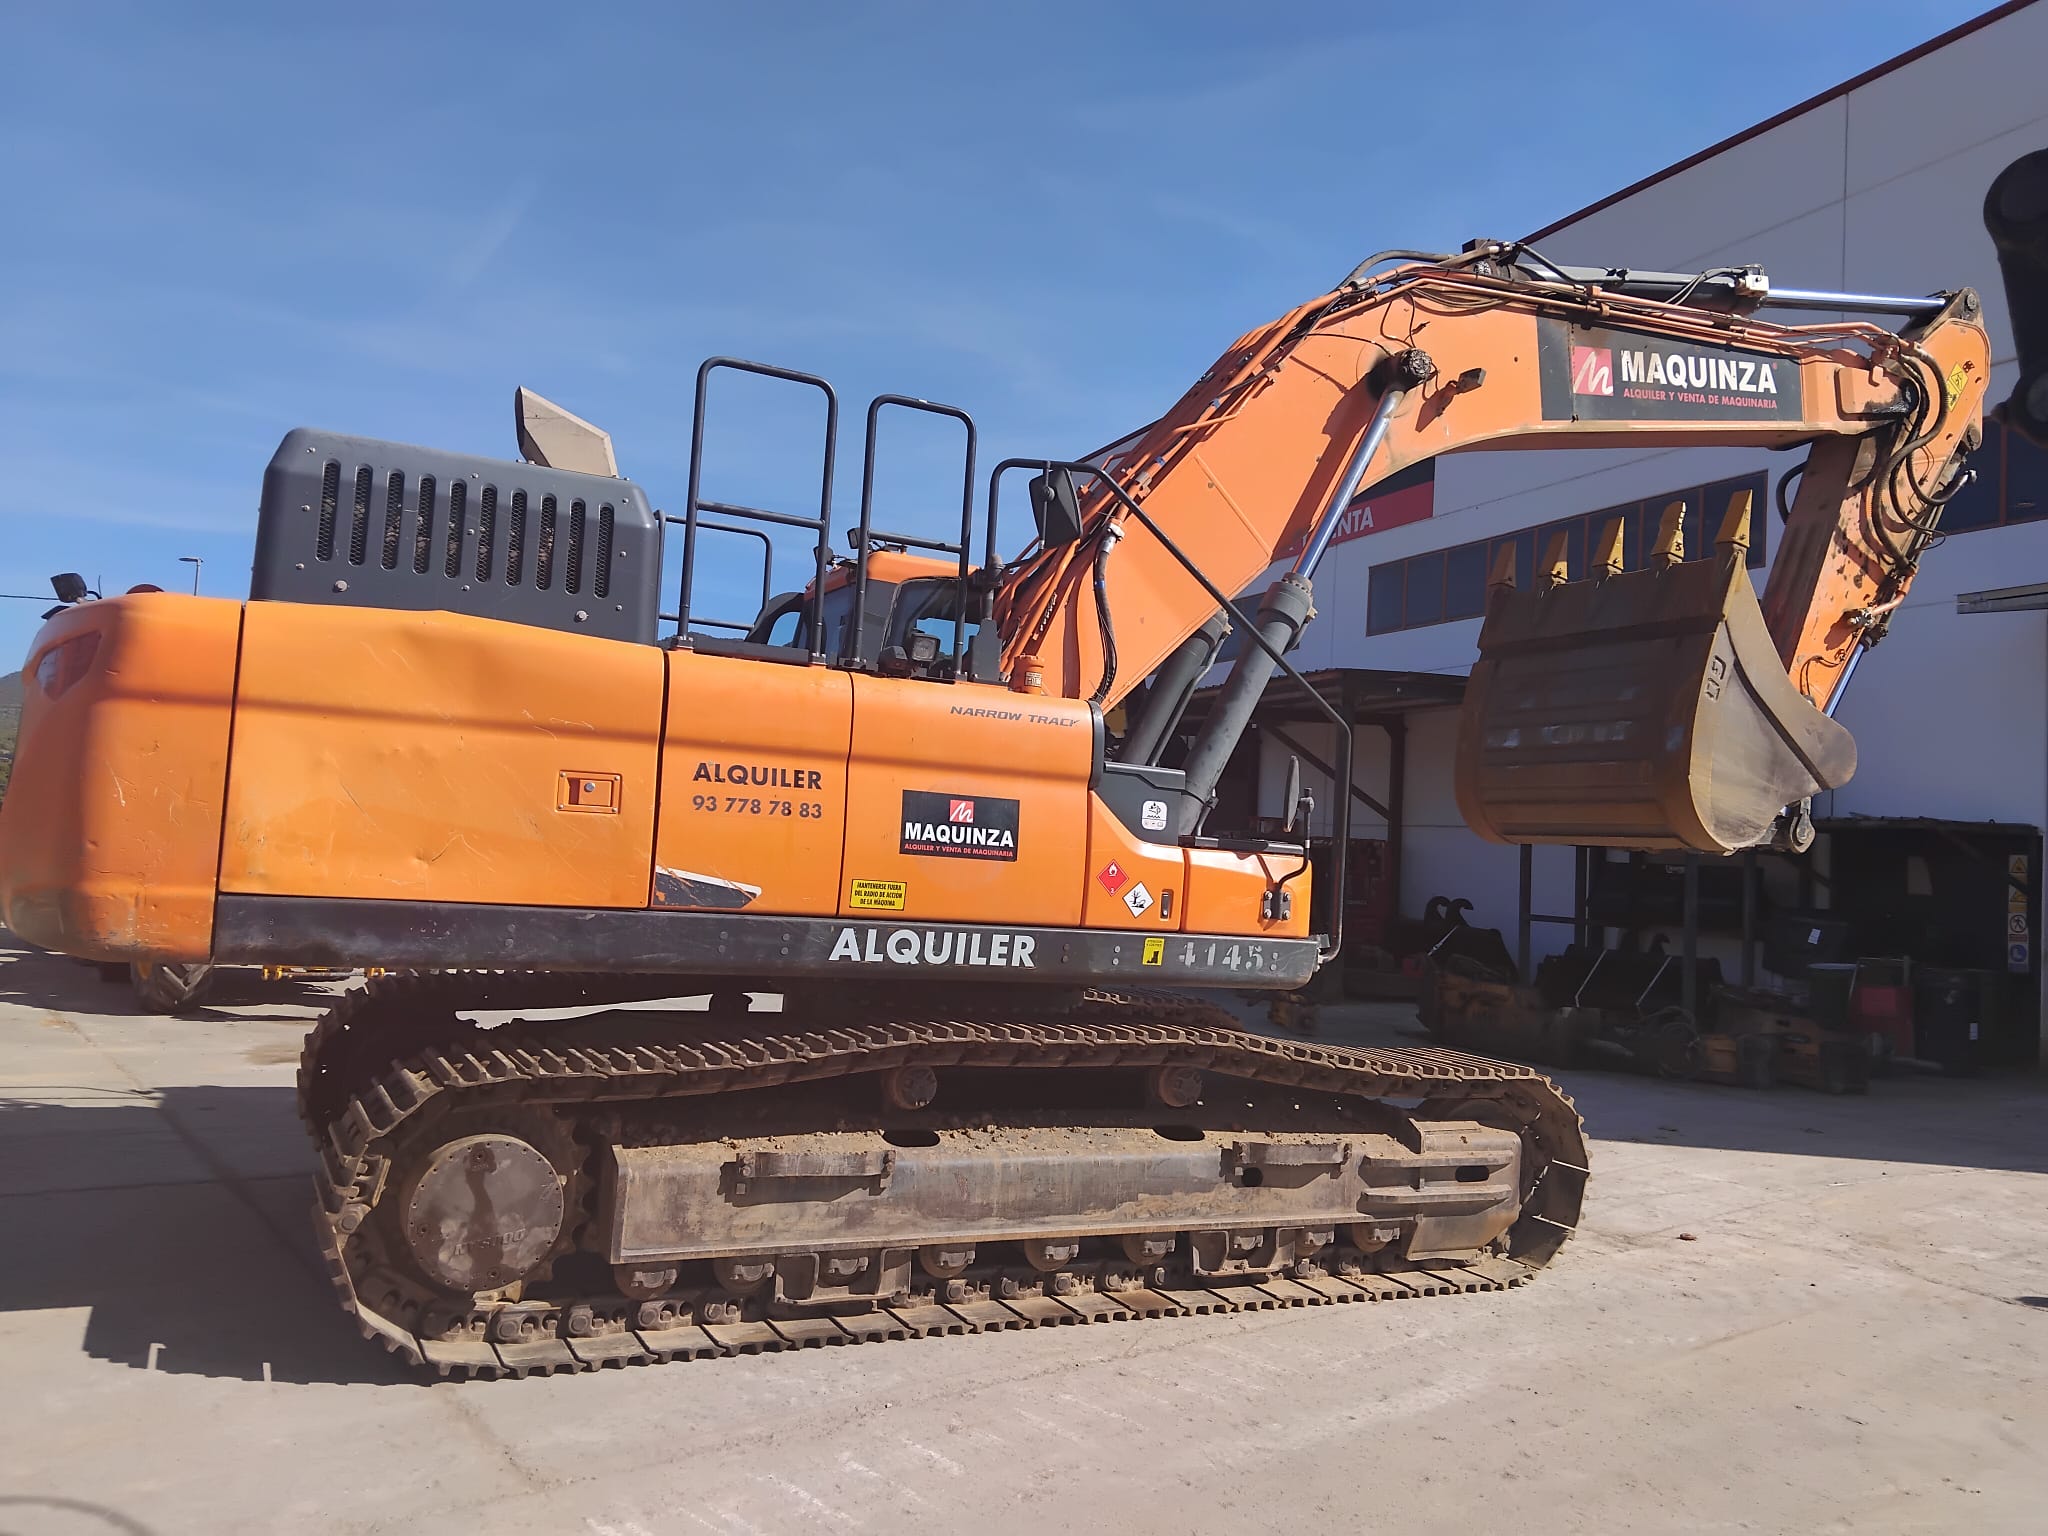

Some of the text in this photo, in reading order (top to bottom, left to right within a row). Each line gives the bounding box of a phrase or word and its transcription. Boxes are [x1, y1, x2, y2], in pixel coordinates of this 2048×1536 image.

[1621, 350, 1777, 394] MAQUINZA
[1624, 388, 1777, 409] ALQUILER Y VENTA DE MAQUINARIA
[950, 706, 1022, 720] NARROW
[693, 762, 822, 790] ALQUILER
[692, 795, 822, 819] 93 778 78 83
[905, 822, 1014, 848] MAQUINZA
[904, 843, 934, 851] ALQUILER
[972, 848, 1013, 857] MAQUINARIA
[854, 889, 863, 897] DEL
[857, 882, 887, 890] MANTENERSE
[828, 927, 1036, 968] ALQUILER
